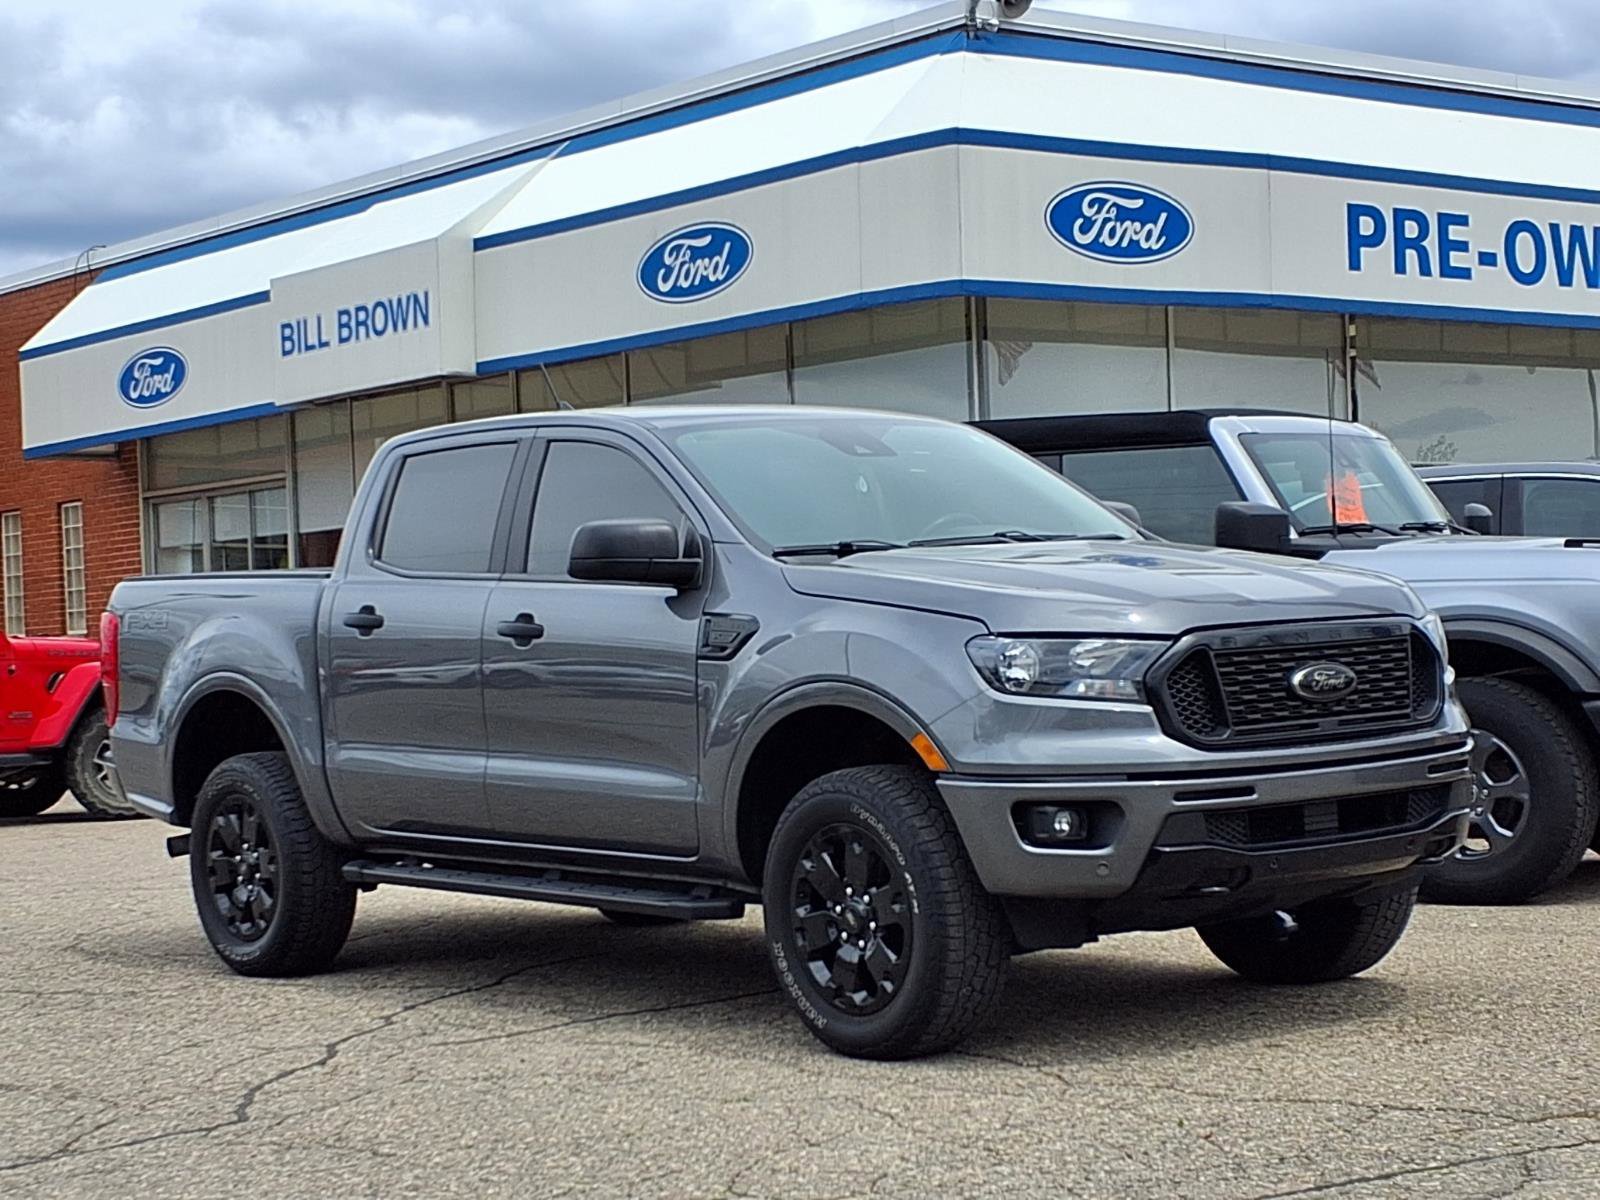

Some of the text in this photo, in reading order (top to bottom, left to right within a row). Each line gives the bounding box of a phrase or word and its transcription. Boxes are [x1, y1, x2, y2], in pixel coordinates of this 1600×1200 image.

[1072, 192, 1168, 250] Ford
[657, 233, 731, 293] Ford
[280, 289, 430, 358] BILL BROWN
[129, 356, 176, 400] Ford
[1311, 670, 1346, 691] Ford
